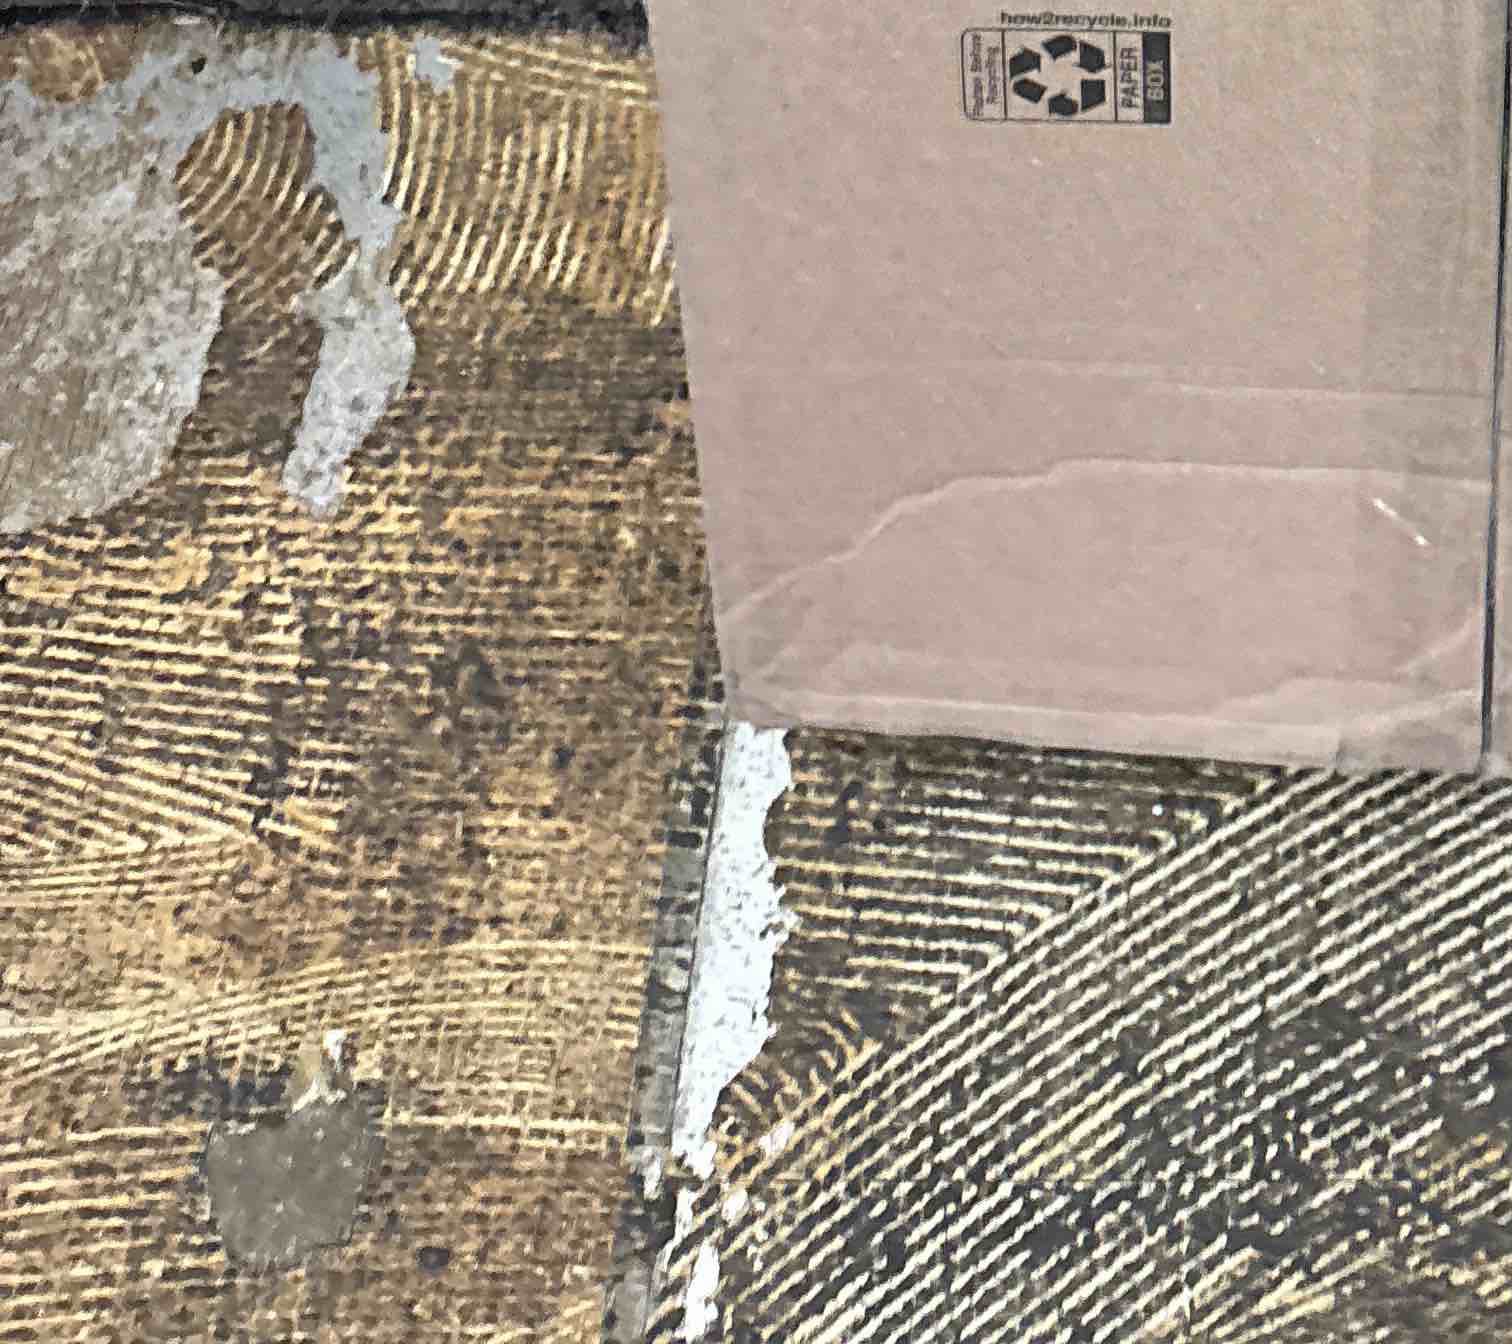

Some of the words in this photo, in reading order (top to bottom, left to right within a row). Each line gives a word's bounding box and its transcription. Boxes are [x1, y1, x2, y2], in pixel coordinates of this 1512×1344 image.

[1001, 11, 1172, 28] how2recycle.info
[1120, 47, 1138, 108] PAPER
[1147, 60, 1164, 101] BOX
